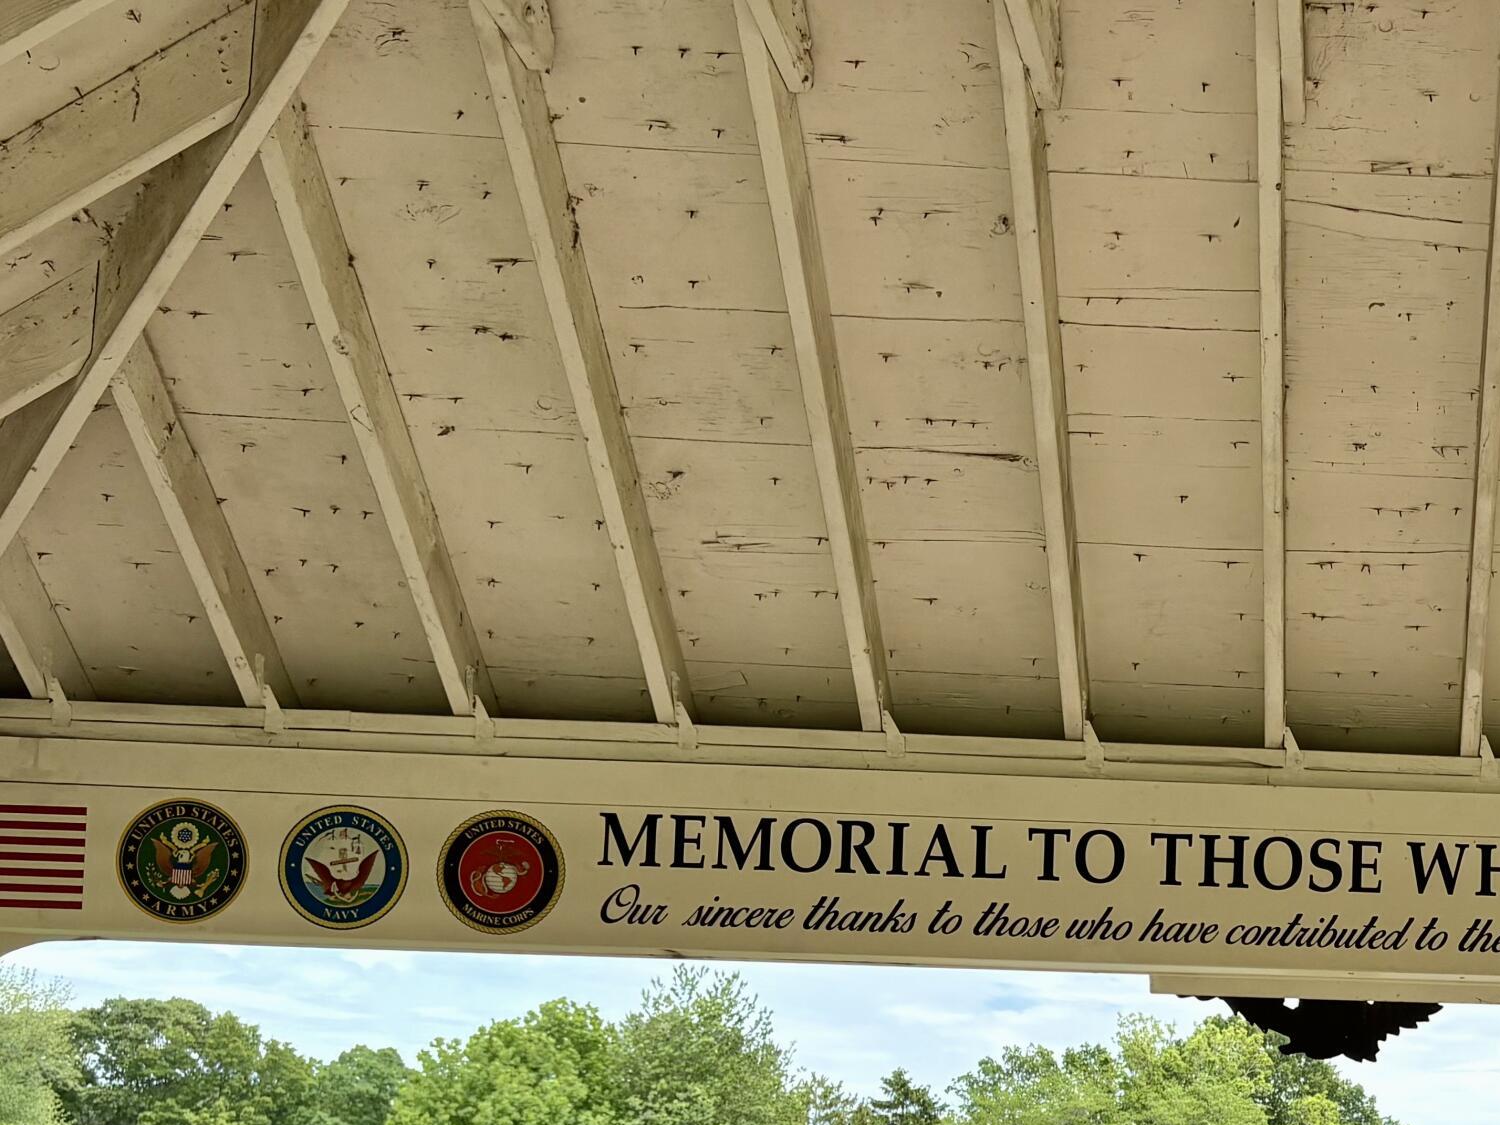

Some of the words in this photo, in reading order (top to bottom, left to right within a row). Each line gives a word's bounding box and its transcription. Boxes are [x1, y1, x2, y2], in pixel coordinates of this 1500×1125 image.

[132, 806, 185, 840] UNITED
[191, 807, 239, 847] STATES
[295, 815, 342, 847] UNITED
[351, 816, 394, 851] STATES
[464, 819, 505, 839] UNITED
[507, 820, 544, 844] STATES
[598, 812, 1008, 879] MEMORIAL
[1028, 827, 1126, 884] TO
[1150, 832, 1383, 893] THOSE
[152, 901, 208, 916] ARMY
[323, 908, 359, 919] NAVY
[462, 904, 500, 925] MARINE
[503, 907, 535, 925] CORPS
[600, 884, 667, 926] Our
[681, 896, 795, 930] sincere
[802, 896, 917, 934] thanks
[928, 900, 963, 935] to
[973, 902, 1060, 938] those
[1065, 906, 1133, 941] who
[1138, 908, 1219, 944] have
[1225, 913, 1415, 951] contributed
[1415, 917, 1449, 952] to
